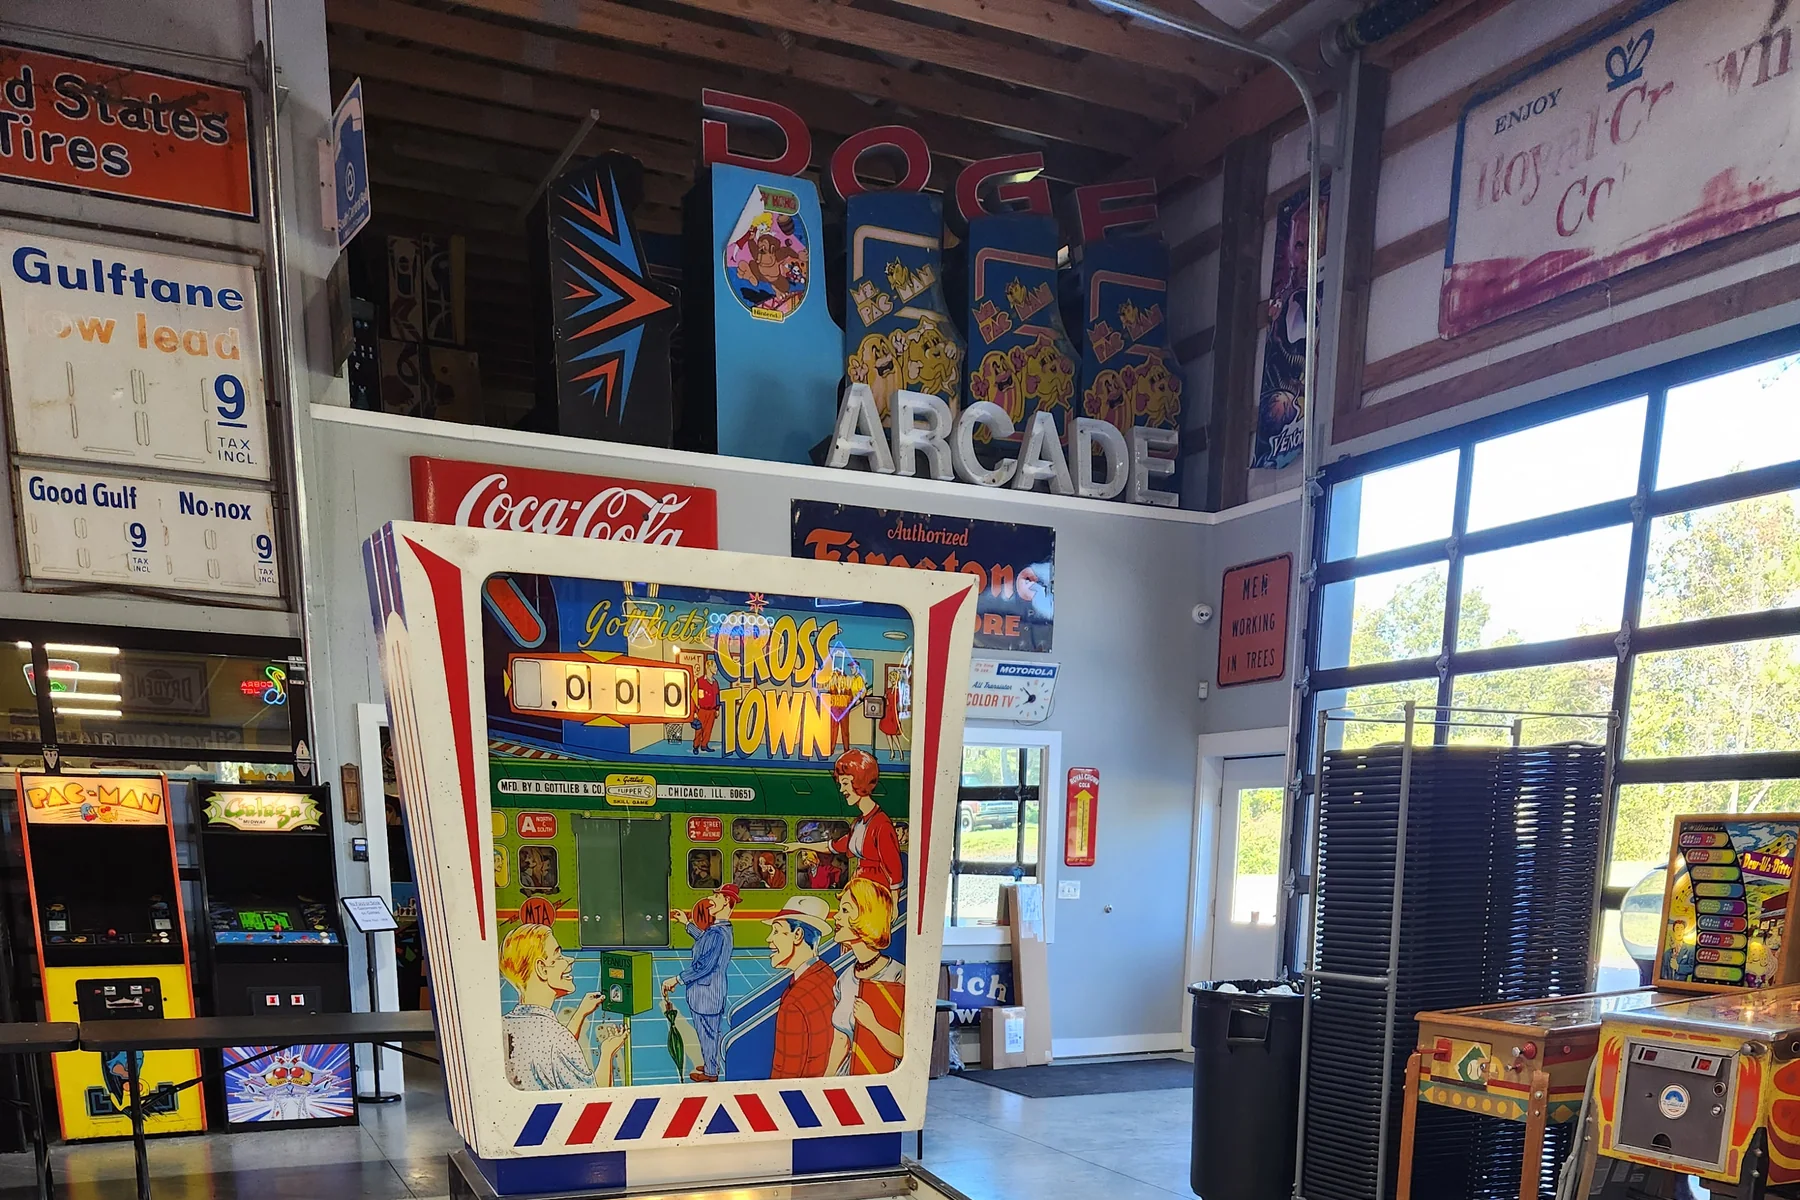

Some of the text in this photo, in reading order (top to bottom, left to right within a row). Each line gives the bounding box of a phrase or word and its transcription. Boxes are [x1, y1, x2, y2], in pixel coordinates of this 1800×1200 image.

[54, 72, 230, 145] States
[1494, 88, 1562, 135] ENJOY
[0, 111, 131, 178] Tires
[12, 246, 244, 312] Gulftane
[136, 313, 240, 360] lead
[214, 373, 246, 420] 9
[218, 437, 251, 450] TAX
[825, 382, 1180, 508] ARCADE
[218, 451, 258, 465] INCL.
[29, 476, 137, 510] Good Gulf
[455, 474, 692, 546] Coca-Cola
[130, 522, 147, 548] 9
[887, 520, 969, 547] Authorized
[256, 534, 273, 560] 9
[133, 557, 149, 565] TAX
[259, 568, 274, 576] TAX
[1243, 574, 1268, 600] MEN
[577, 600, 709, 648] Gottlieb's
[1232, 613, 1275, 637] WORKING
[717, 611, 838, 684] CROSS
[1227, 648, 1275, 673] IN TREES
[1000, 666, 1053, 676] MOTOROLA
[966, 693, 1015, 707] COLOR TV
[720, 687, 832, 757] TOWN
[26, 782, 161, 815] PAC-MAN
[501, 780, 605, 794] MFD. BY D. GOTTLIEB & CO.
[711, 788, 727, 799] ILL.
[730, 788, 752, 799] 60651
[224, 797, 303, 829] Galaga
[521, 816, 536, 833] A
[703, 820, 721, 828] STREET
[525, 903, 550, 925] MTA
[602, 956, 631, 967] PEANUTS
